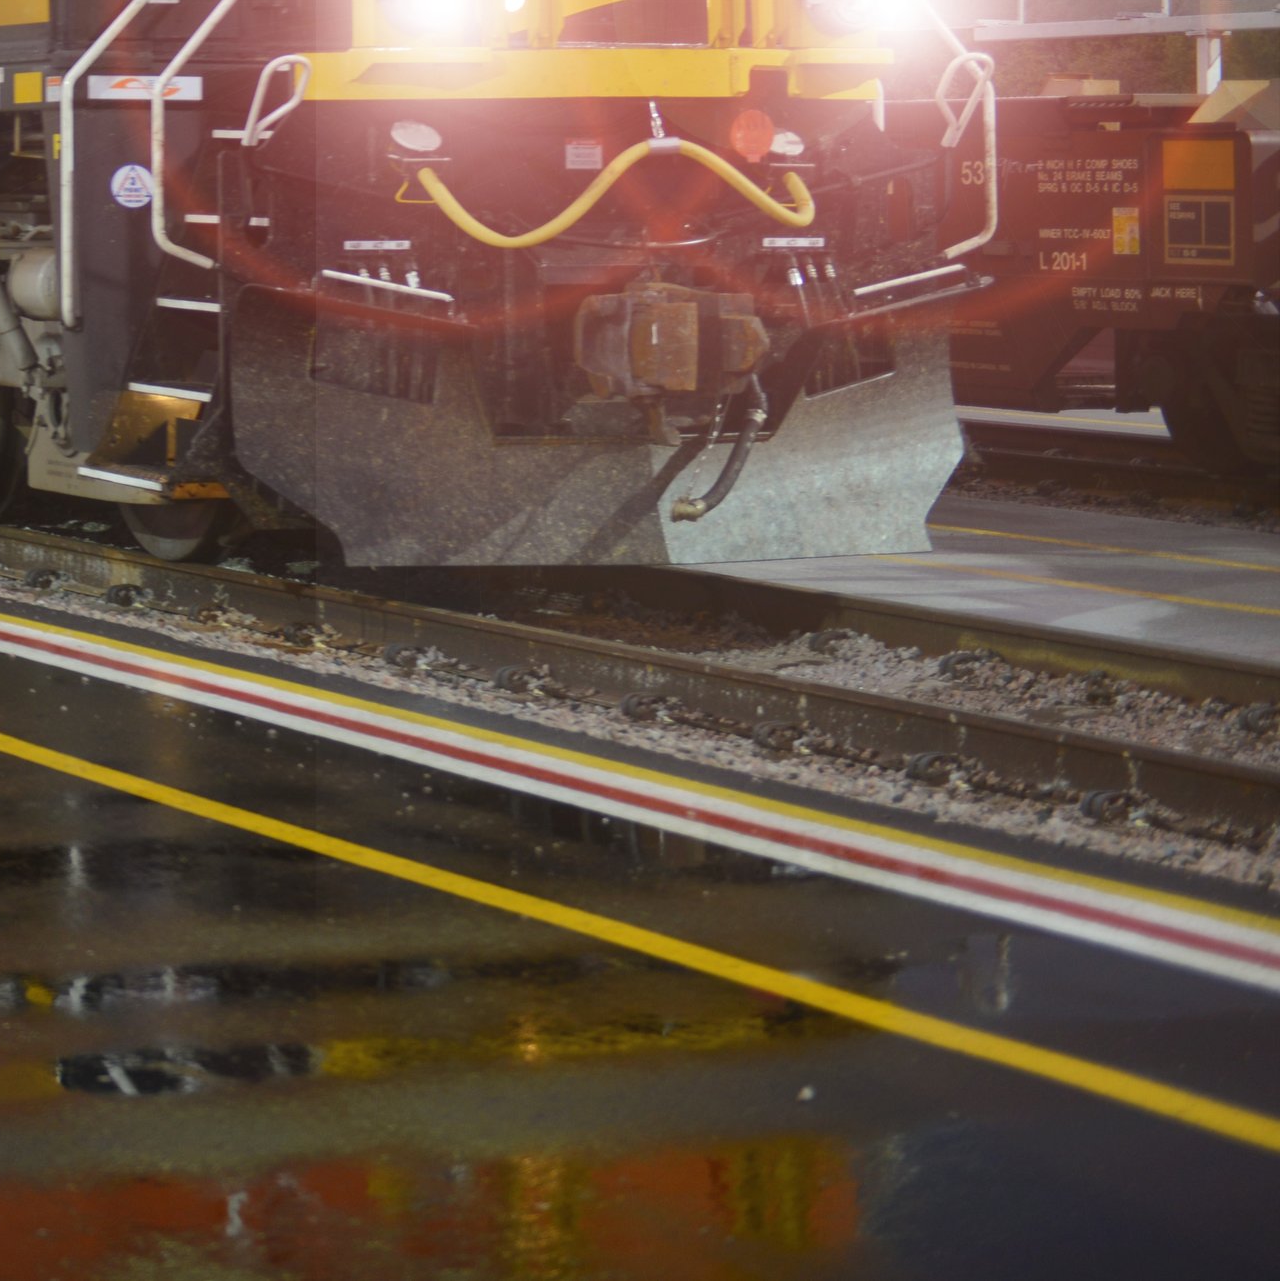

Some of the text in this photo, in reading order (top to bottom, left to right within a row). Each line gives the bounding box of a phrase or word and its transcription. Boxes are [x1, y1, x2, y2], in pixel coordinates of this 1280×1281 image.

[1112, 159, 1138, 169] SHOES
[1040, 229, 1062, 238] MINER
[1040, 251, 1088, 270] L 201-1
[1151, 288, 1197, 298] JACK HERE
